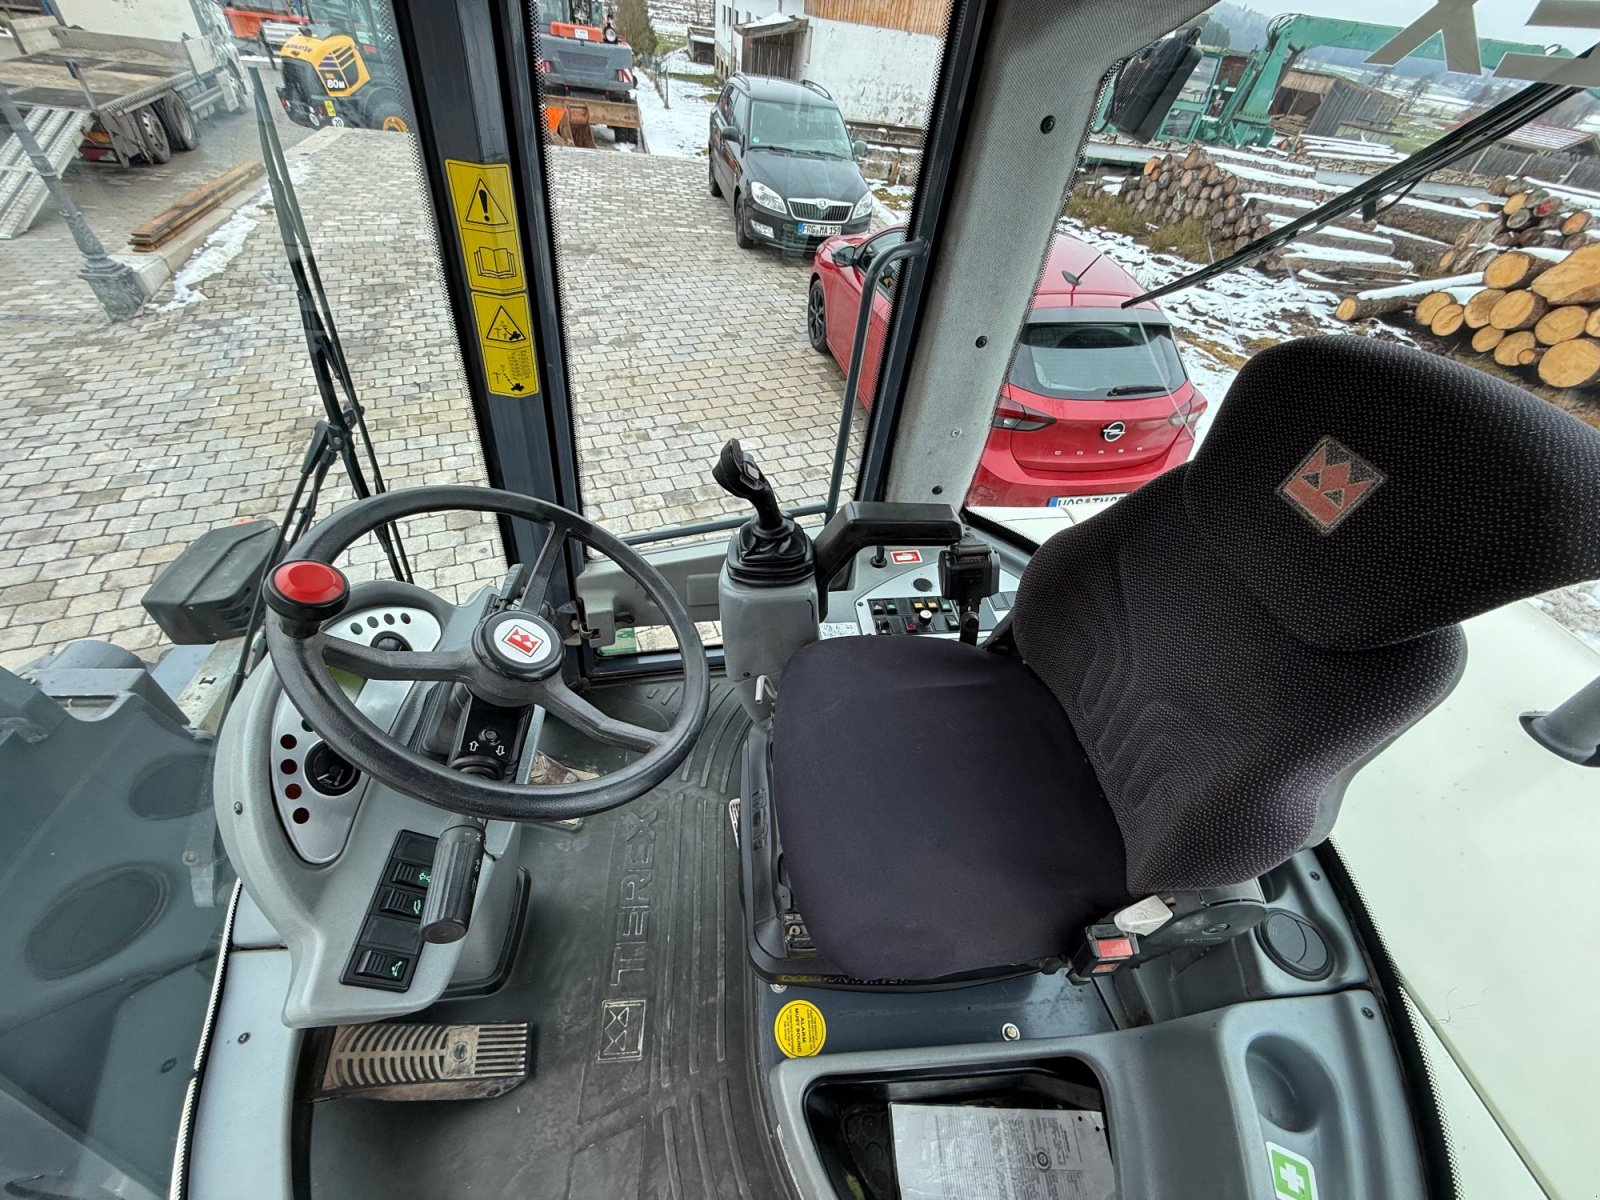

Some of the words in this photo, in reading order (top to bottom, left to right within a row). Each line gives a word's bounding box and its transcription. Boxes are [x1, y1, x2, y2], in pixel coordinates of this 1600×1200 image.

[803, 224, 816, 234] FRG
[819, 226, 828, 235] MA
[609, 810, 658, 986] TEREX
